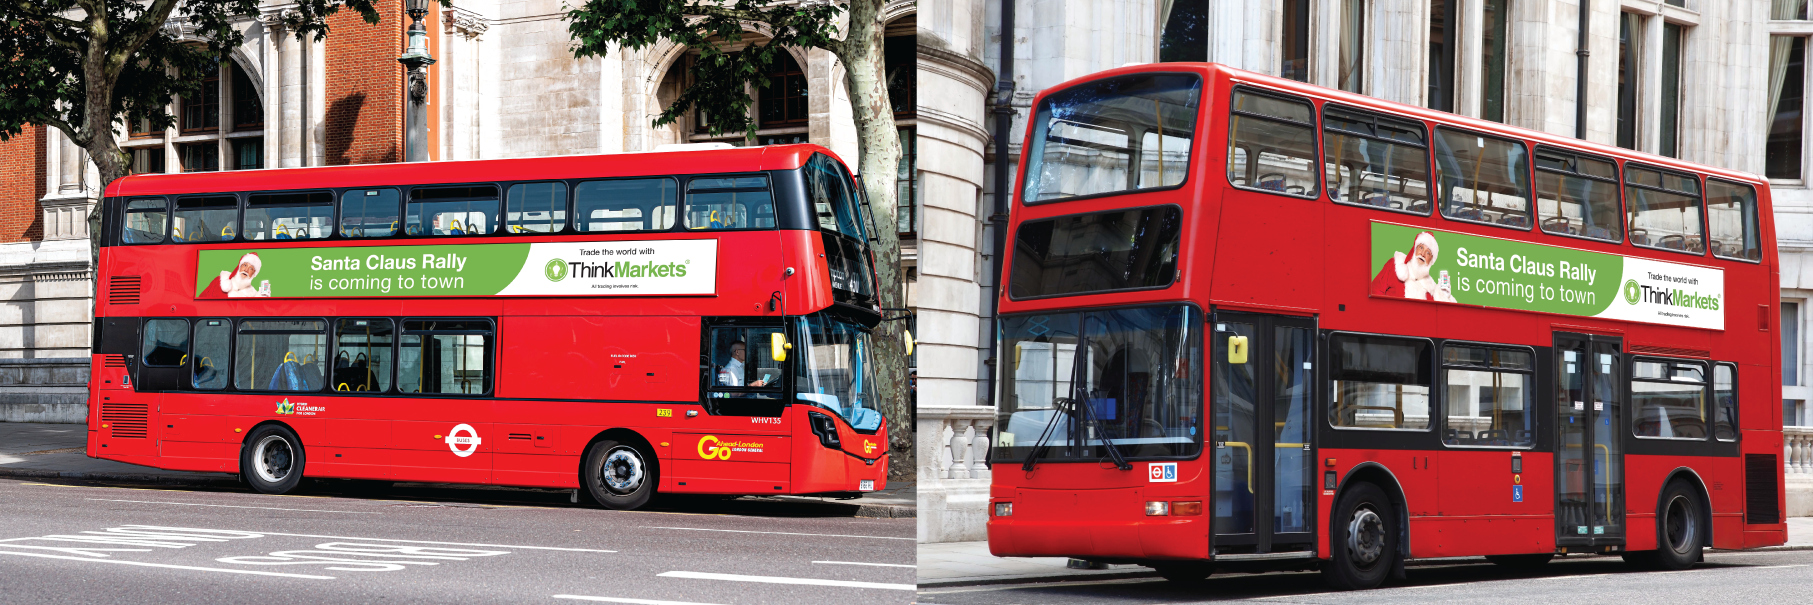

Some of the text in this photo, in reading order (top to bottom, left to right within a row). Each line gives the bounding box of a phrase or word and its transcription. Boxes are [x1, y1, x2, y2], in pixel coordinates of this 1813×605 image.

[579, 248, 600, 256] Trade
[615, 248, 637, 256] world
[639, 247, 655, 255] with
[310, 253, 467, 273] Santa Claus Rally
[568, 260, 687, 279] ThinkMarkets
[1456, 247, 1597, 286] Santa Claus Rally
[310, 274, 464, 293] is coming to town
[1648, 272, 1662, 280] Trade
[1663, 274, 1672, 282] the
[1673, 276, 1688, 284] world
[1457, 271, 1596, 306] is coming to town
[1640, 285, 1719, 310] ThinkMarkets
[751, 416, 782, 425] WHV135
[697, 435, 732, 461] Go
[215, 542, 512, 572] BUS
